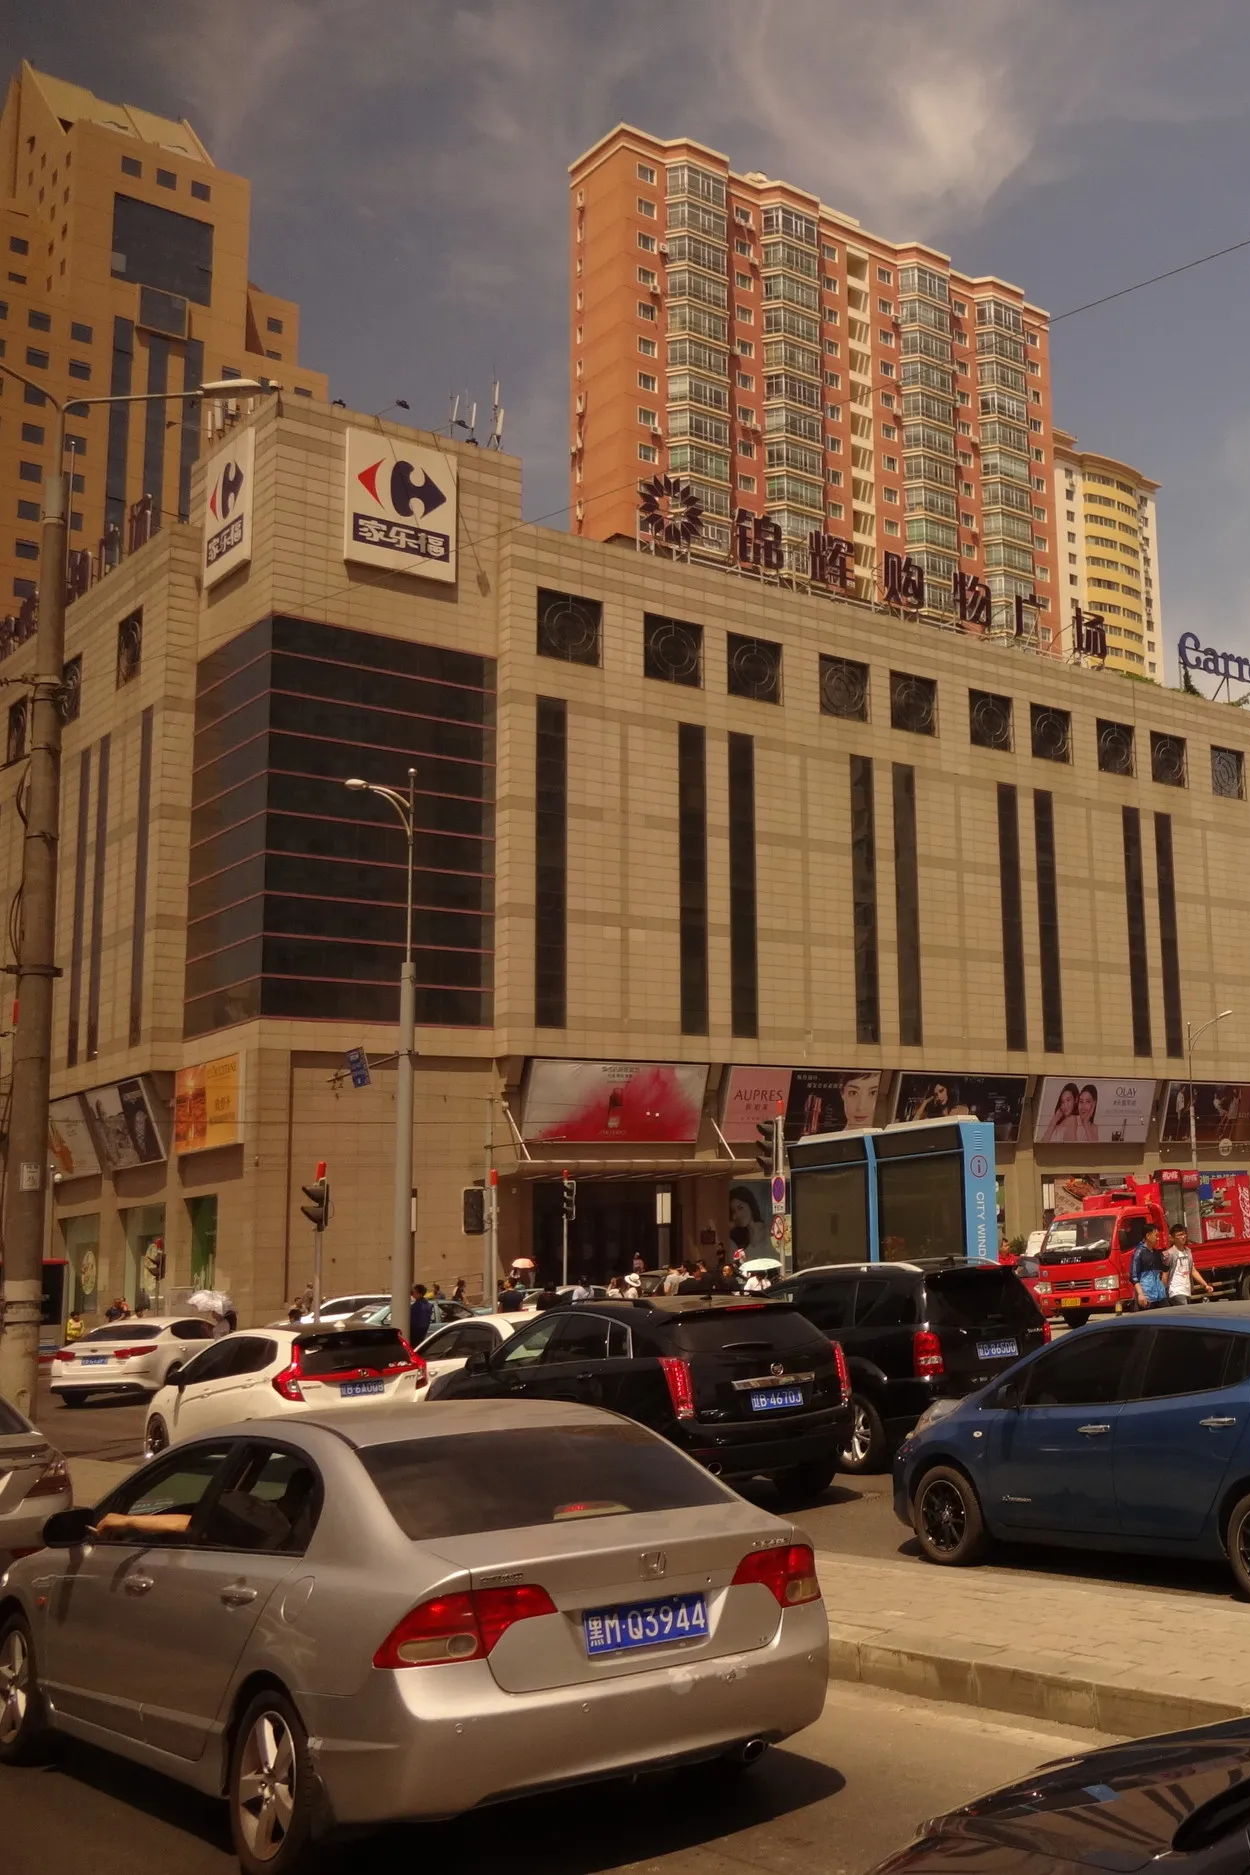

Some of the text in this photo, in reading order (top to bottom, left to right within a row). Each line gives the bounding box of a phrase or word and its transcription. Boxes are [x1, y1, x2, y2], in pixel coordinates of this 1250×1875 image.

[207, 518, 243, 562] 家乐福
[357, 517, 447, 558] 家乐福
[733, 1089, 784, 1102] AUPRES
[1115, 1086, 1139, 1097] OLAY
[976, 1191, 987, 1264] CITY WIND
